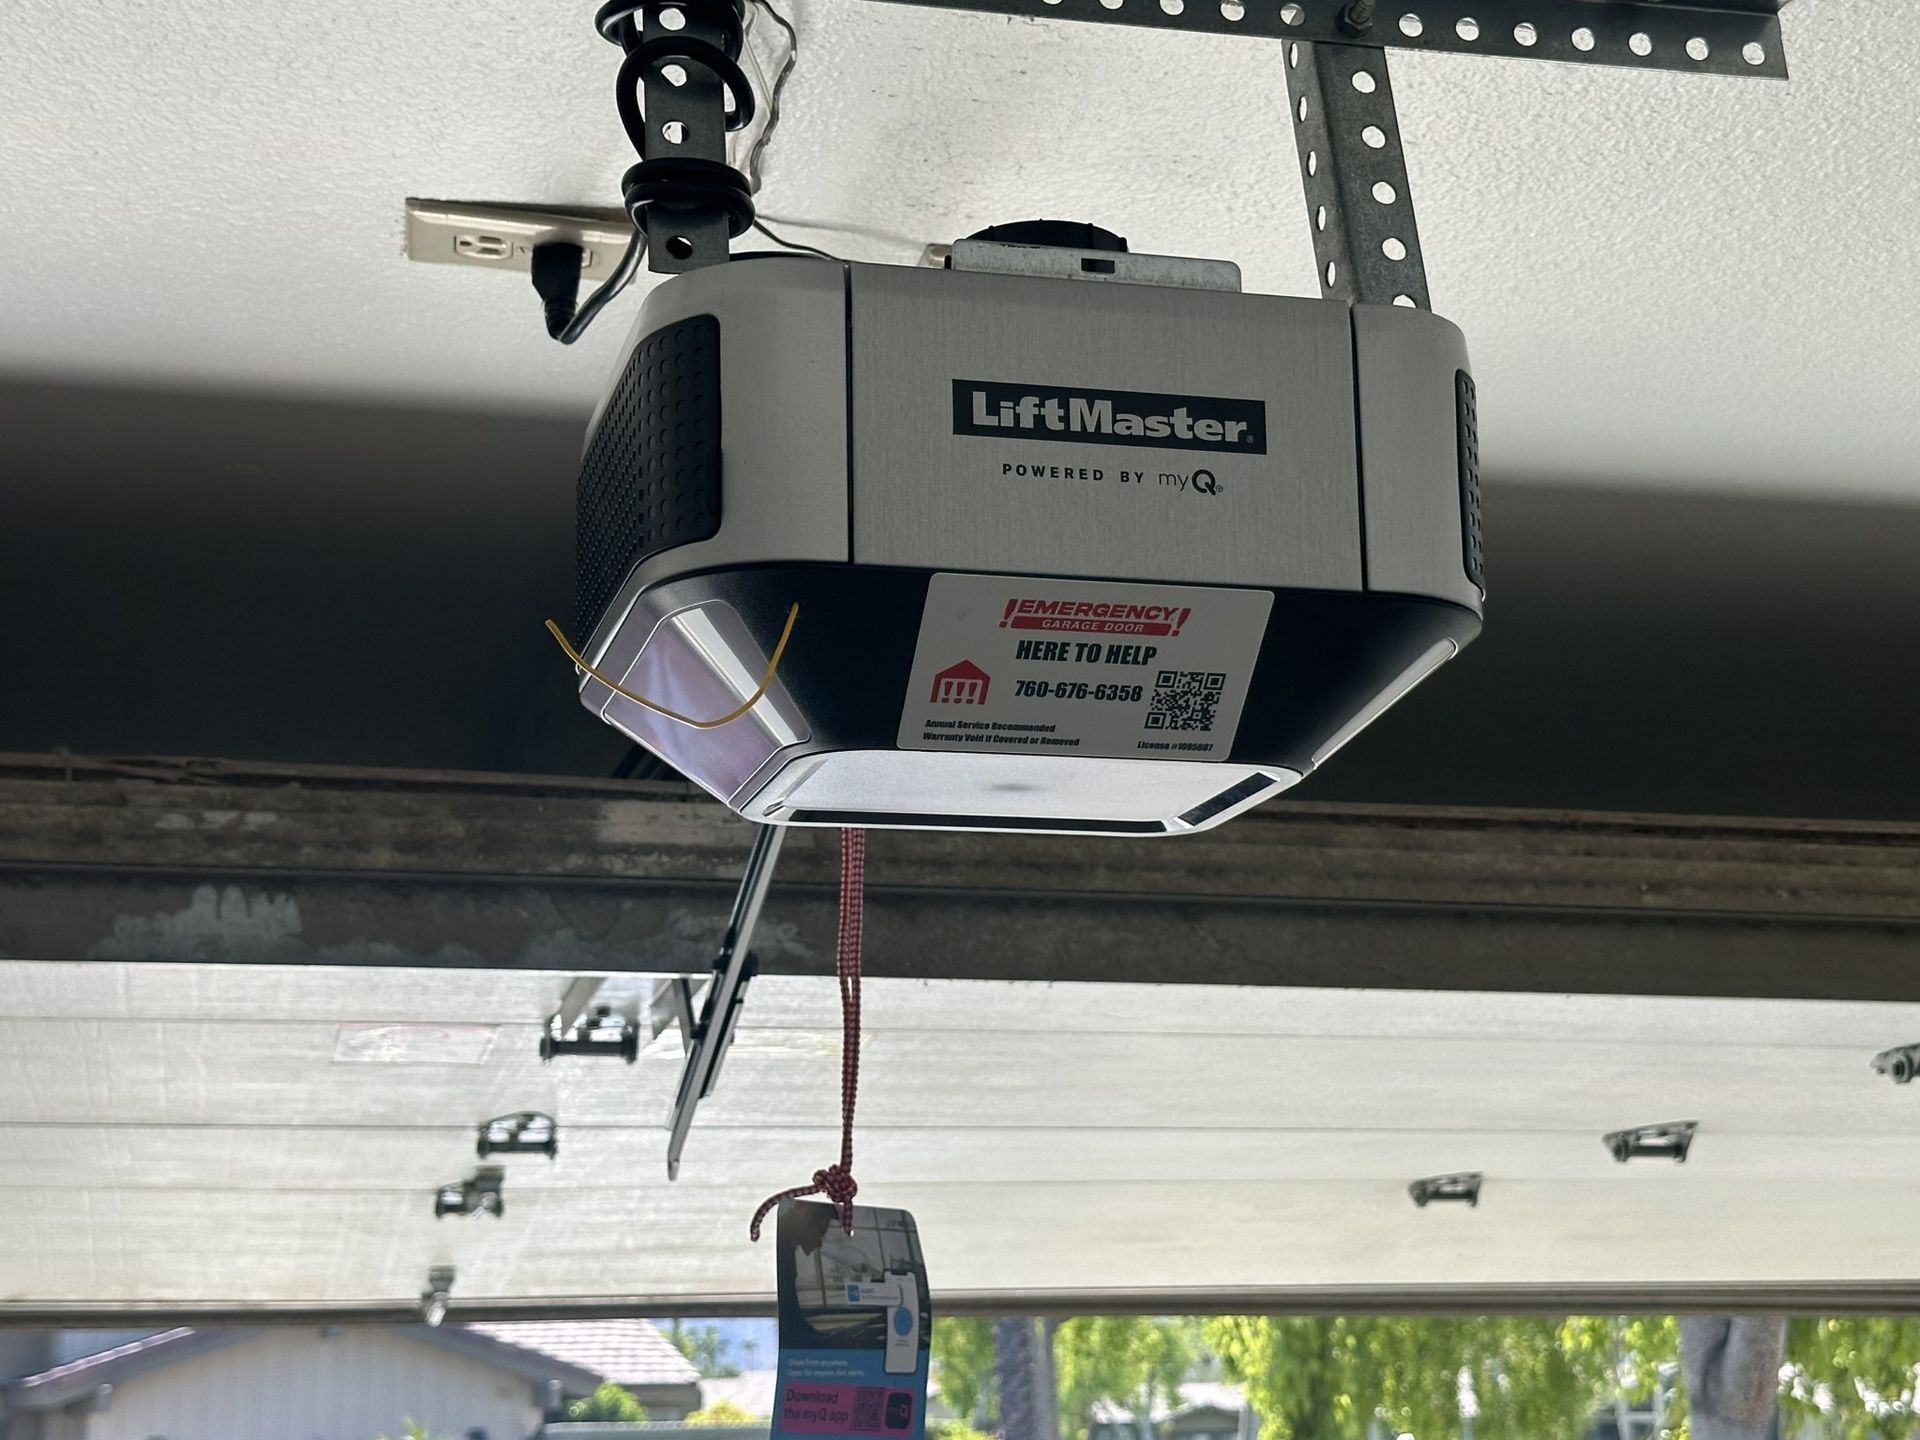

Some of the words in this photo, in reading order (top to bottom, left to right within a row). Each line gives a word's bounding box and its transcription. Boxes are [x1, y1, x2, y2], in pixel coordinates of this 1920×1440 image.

[1002, 463, 1104, 481] POWERED
[1120, 471, 1145, 483] BY
[1042, 618, 1100, 631] GARAGE
[1103, 622, 1145, 633] DOOR
[1015, 640, 1071, 662] HERE
[1075, 642, 1102, 663] TO
[1104, 644, 1157, 665] HELP
[1014, 680, 1143, 702] 760-676-6358
[925, 719, 956, 728] Annual
[957, 720, 990, 730] Service
[991, 722, 1056, 732] Recommended
[923, 732, 964, 742] Warranty
[964, 733, 984, 742] Void
[993, 735, 1029, 744] Covered
[1029, 737, 1040, 745] or
[1040, 737, 1080, 746] Removed
[1137, 741, 1170, 750] License
[785, 1388, 839, 1404] Download
[784, 1408, 800, 1419] the
[802, 1408, 828, 1423] myQ
[829, 1411, 848, 1425] app
